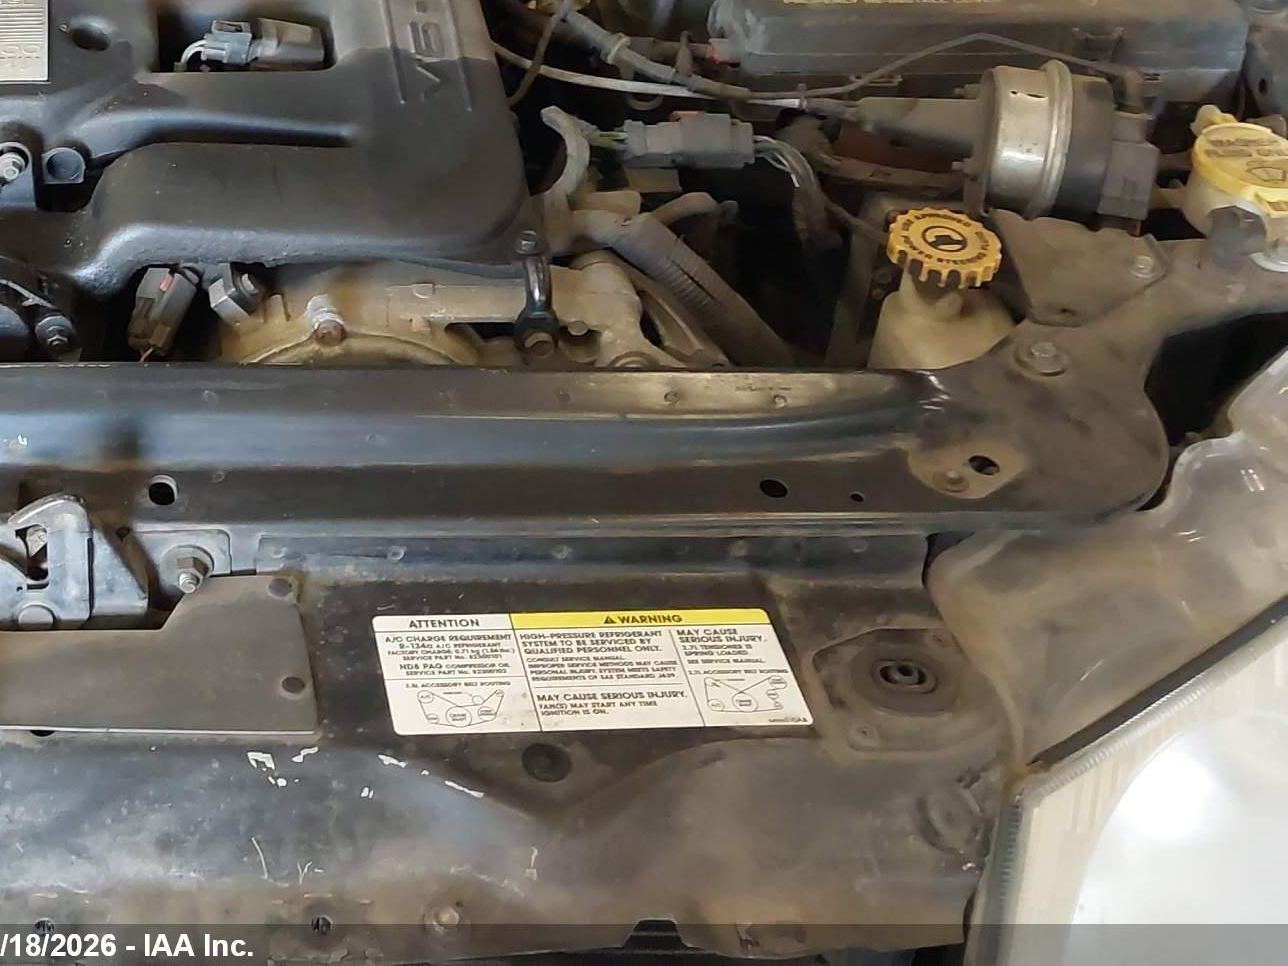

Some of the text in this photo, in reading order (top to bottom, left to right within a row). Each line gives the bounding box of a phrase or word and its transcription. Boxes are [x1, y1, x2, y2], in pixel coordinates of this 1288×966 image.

[409, 619, 480, 629] ATTENTION
[618, 615, 683, 624] WARNING
[406, 635, 447, 643] CHARGE
[449, 634, 512, 642] REQUIREMENT
[599, 630, 663, 638] REFRIGERANT
[590, 638, 637, 646] SERVICED
[524, 647, 574, 655] QUALIFIED
[577, 646, 632, 654] PERSONNEL
[563, 693, 597, 701] CAUSE
[647, 691, 688, 699] INJURY.
